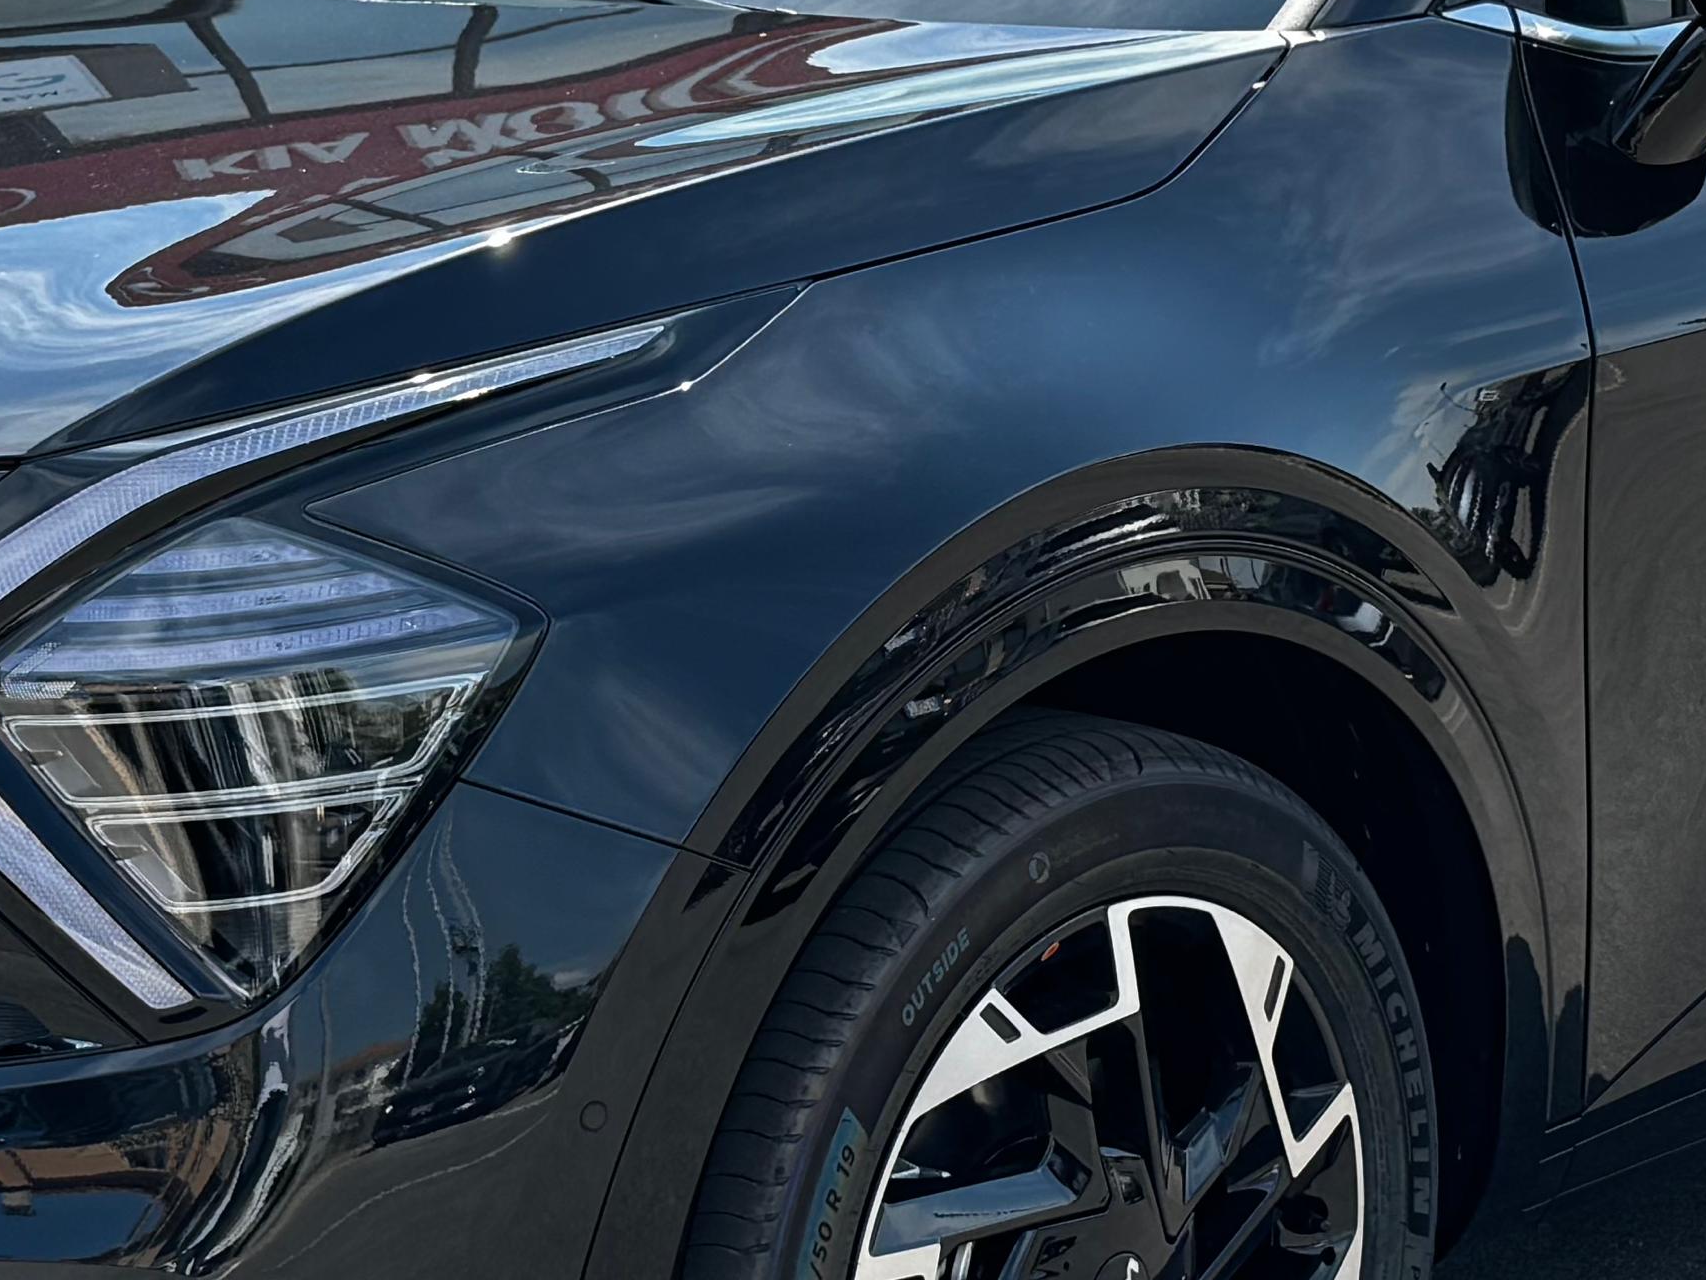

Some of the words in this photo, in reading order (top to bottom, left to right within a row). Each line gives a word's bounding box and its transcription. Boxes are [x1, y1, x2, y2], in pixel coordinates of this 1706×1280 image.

[901, 926, 971, 1027] OUTSIDE
[1351, 919, 1433, 1216] MICHELIN
[825, 1187, 844, 1213] R
[836, 1143, 856, 1179] 19
